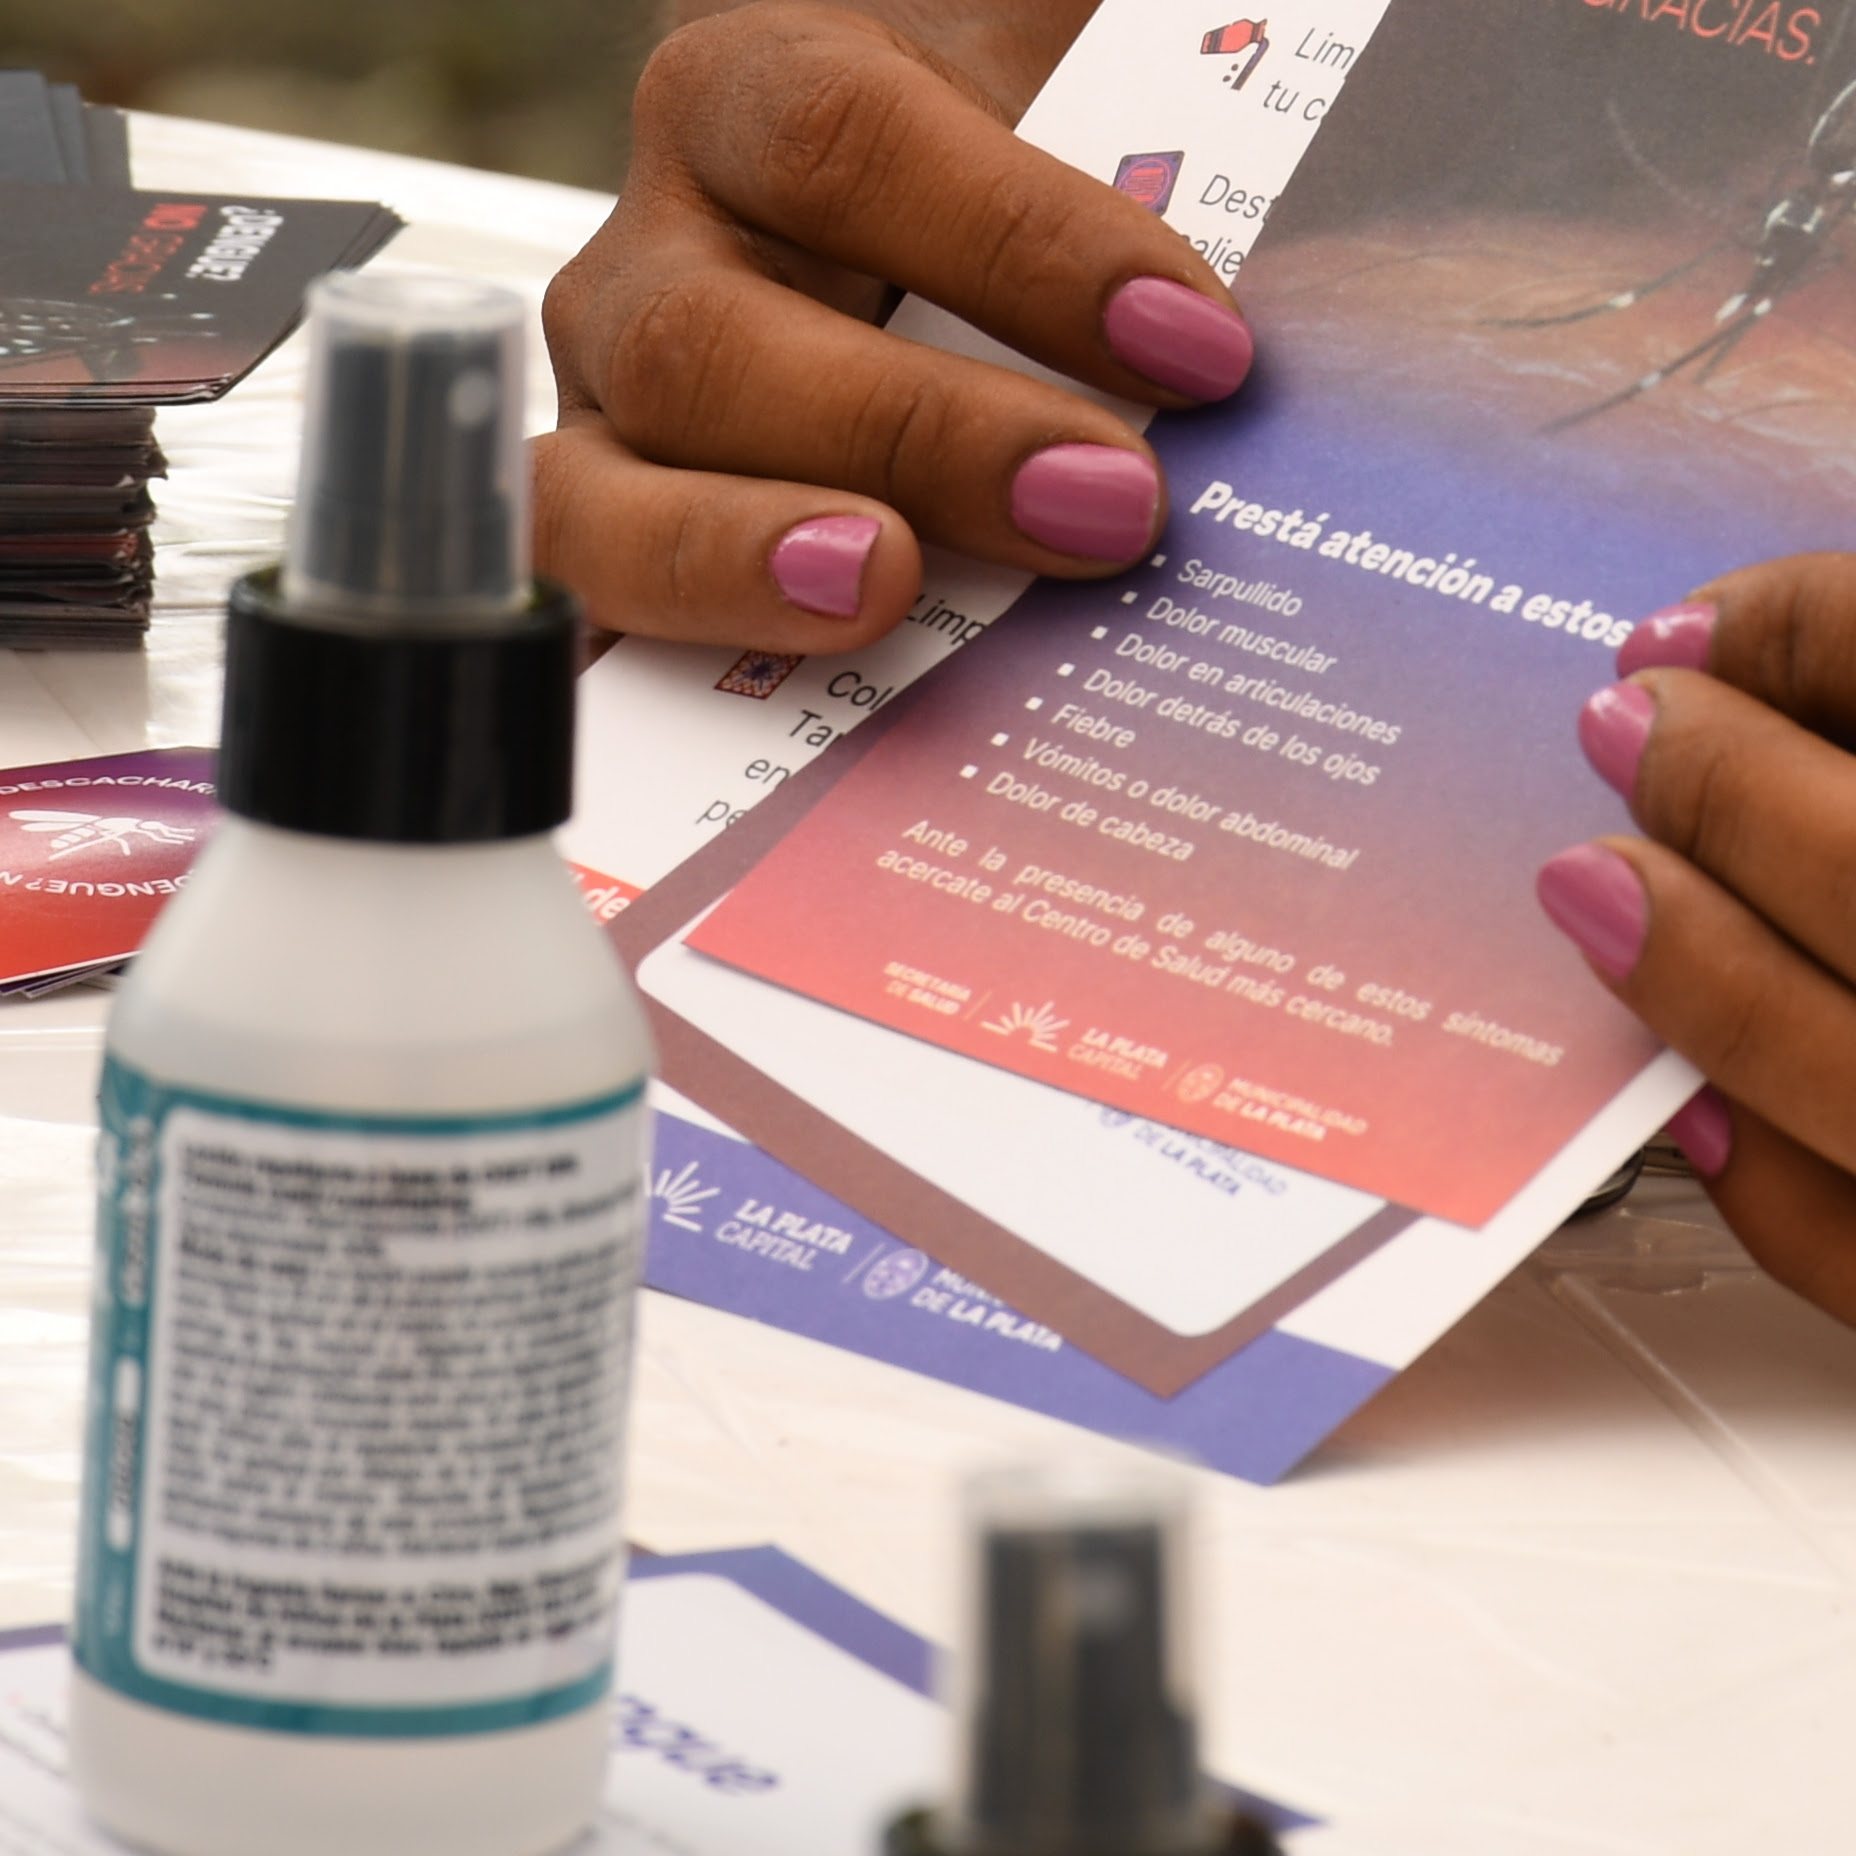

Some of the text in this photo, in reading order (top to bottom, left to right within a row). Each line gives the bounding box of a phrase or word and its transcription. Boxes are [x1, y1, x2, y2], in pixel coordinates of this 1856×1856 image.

[1295, 27, 1356, 70] Lim
[1263, 79, 1300, 114] tu
[1178, 559, 1303, 618] Sarpullido
[1190, 481, 1636, 648] Prestá atención a estos
[904, 593, 987, 645] Limp
[1147, 596, 1338, 675] Dolor muscular
[827, 671, 893, 712] Col
[1116, 633, 1402, 746] Dolor en articulaciones
[788, 710, 844, 747] Ta
[1052, 703, 1136, 749] Fiebre
[1084, 669, 1381, 787] Dolor detrás de los ojos
[987, 772, 1195, 863] Dolor de cabeza
[1024, 736, 1360, 872] Vómitos o dolor abdominal
[876, 849, 1394, 1046] acercate al Centro de Salud más cercano.
[902, 819, 969, 858] Ante
[979, 846, 1007, 873] la
[1013, 864, 1145, 922] presencia
[1156, 910, 1194, 939] de
[1205, 929, 1296, 973] alguno
[1307, 963, 1345, 991] de
[1356, 981, 1433, 1022] estos
[714, 1221, 820, 1271] CAPITAL
[735, 1198, 853, 1255] LA PLATA
[911, 1286, 948, 1313] DE
[948, 1299, 989, 1327] LA
